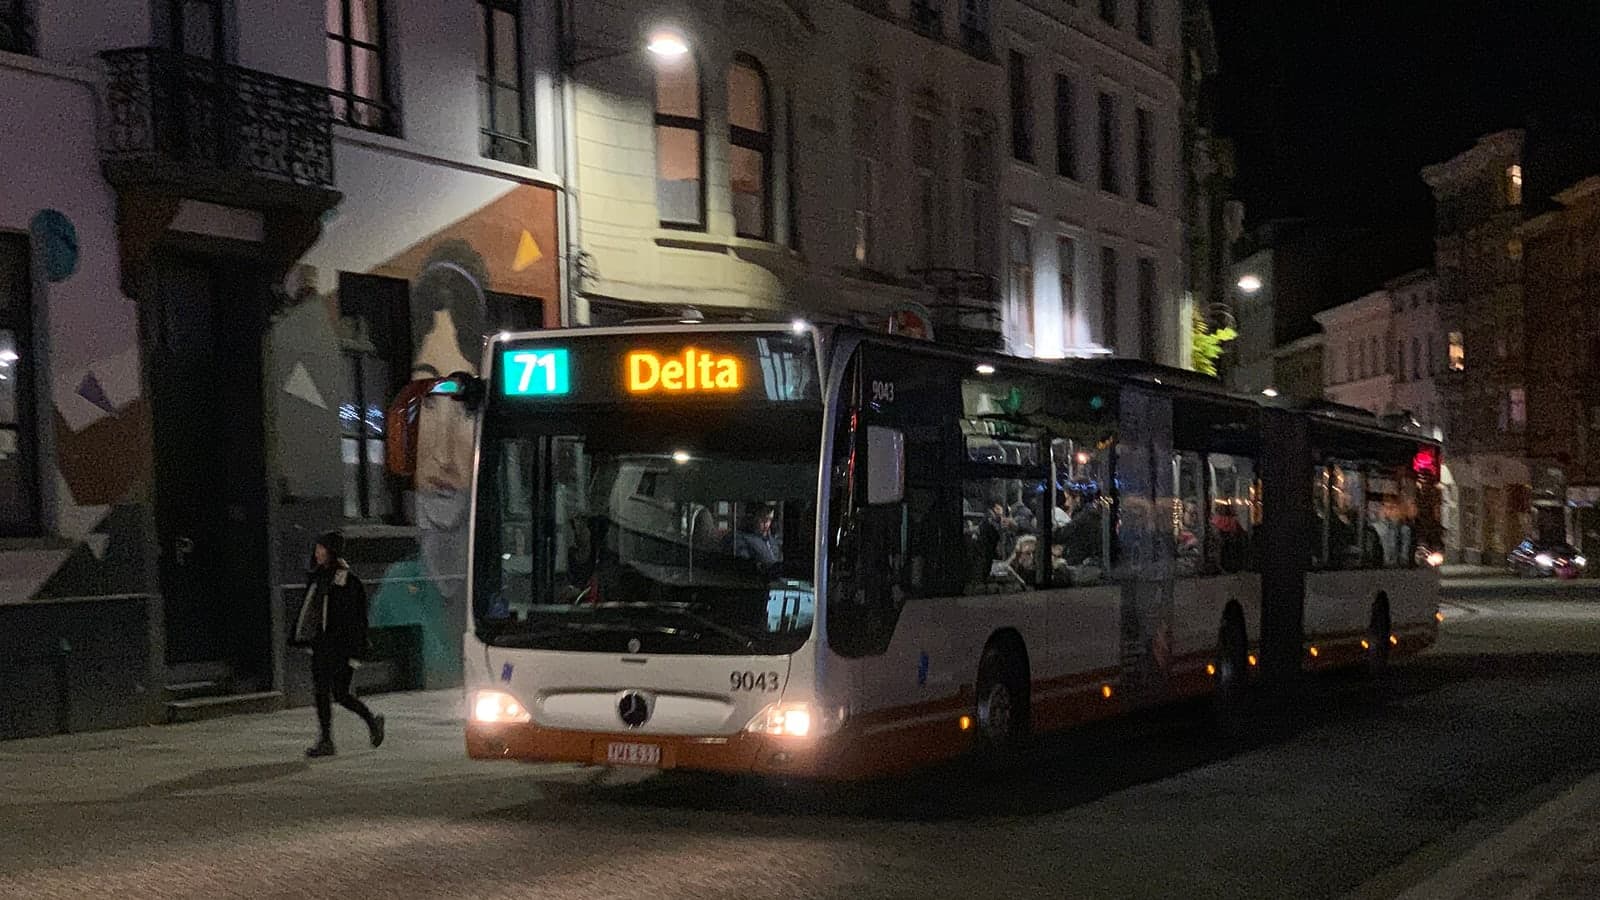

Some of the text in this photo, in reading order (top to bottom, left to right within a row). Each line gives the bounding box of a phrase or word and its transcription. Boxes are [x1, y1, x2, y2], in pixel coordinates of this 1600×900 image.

[513, 353, 556, 392] 71
[628, 350, 739, 392] Delta
[872, 380, 895, 402] 9043
[730, 671, 778, 692] 9043
